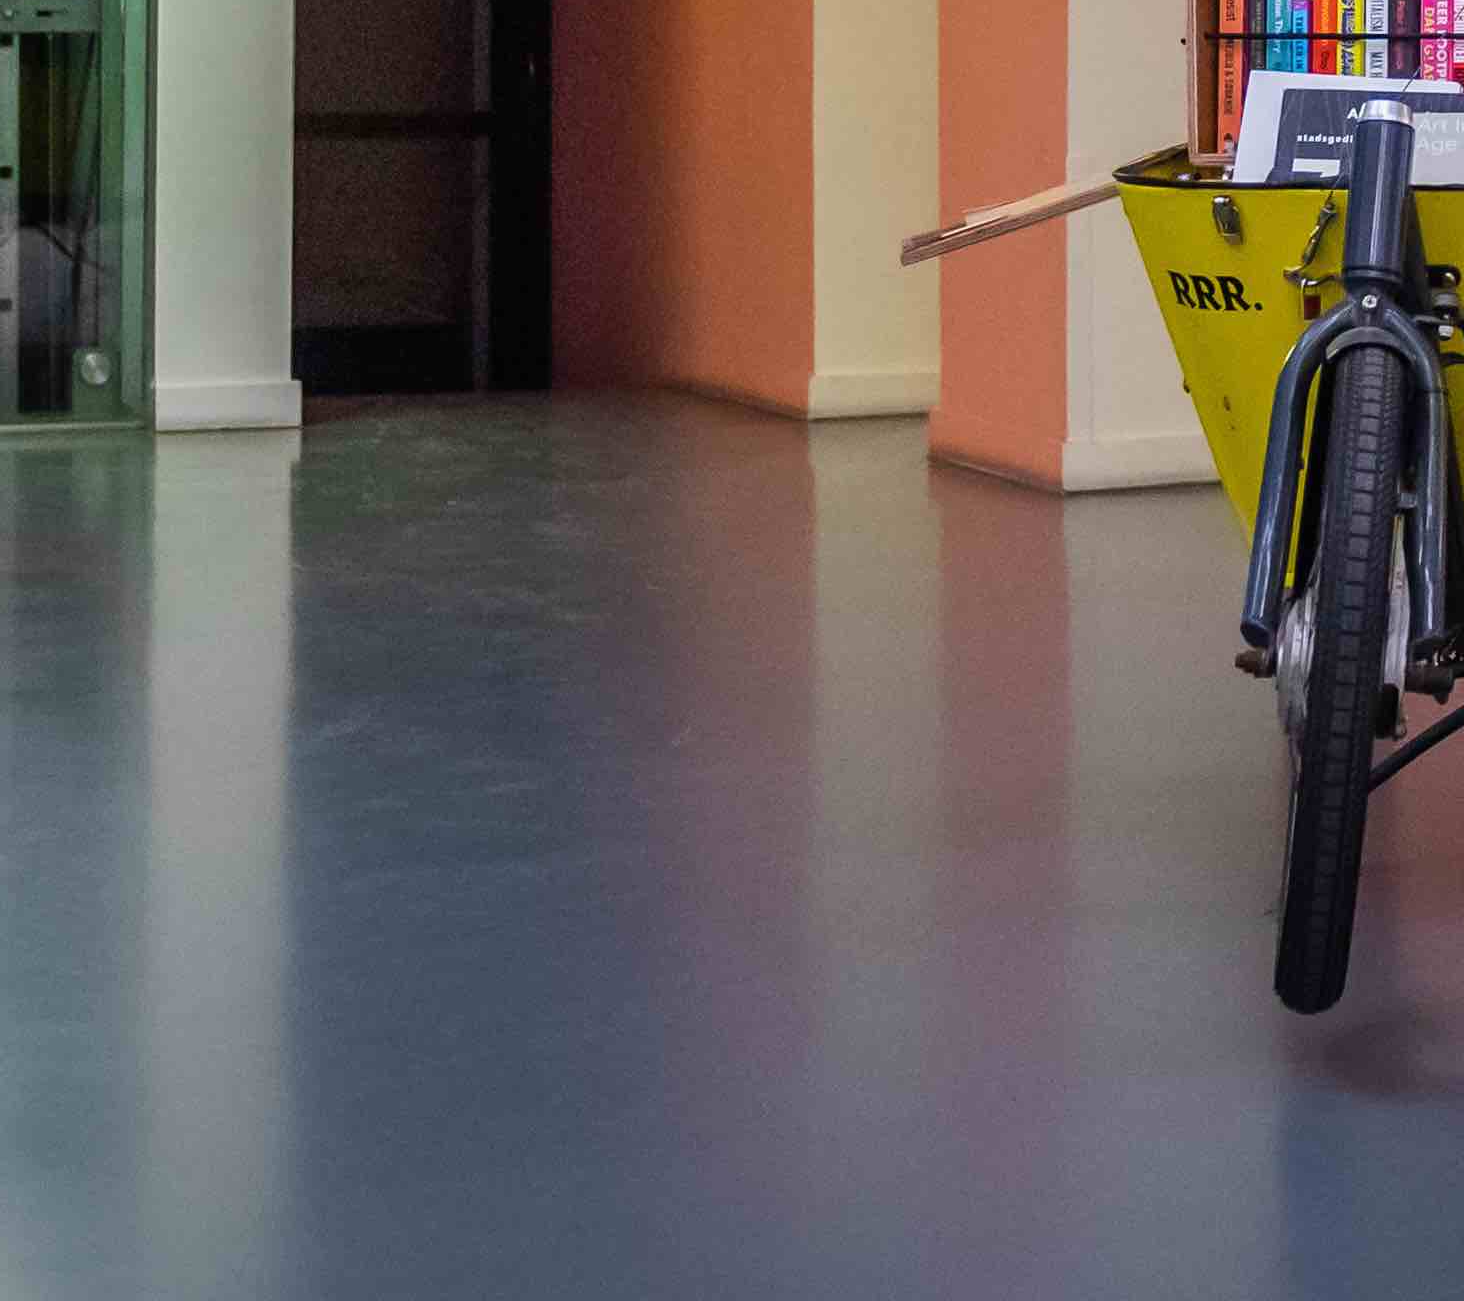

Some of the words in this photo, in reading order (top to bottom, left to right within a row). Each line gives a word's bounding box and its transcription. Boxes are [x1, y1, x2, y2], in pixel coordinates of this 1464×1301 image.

[1368, 51, 1384, 69] MAX
[1296, 134, 1354, 145] stadsgedi
[1168, 270, 1262, 311] RRR.
